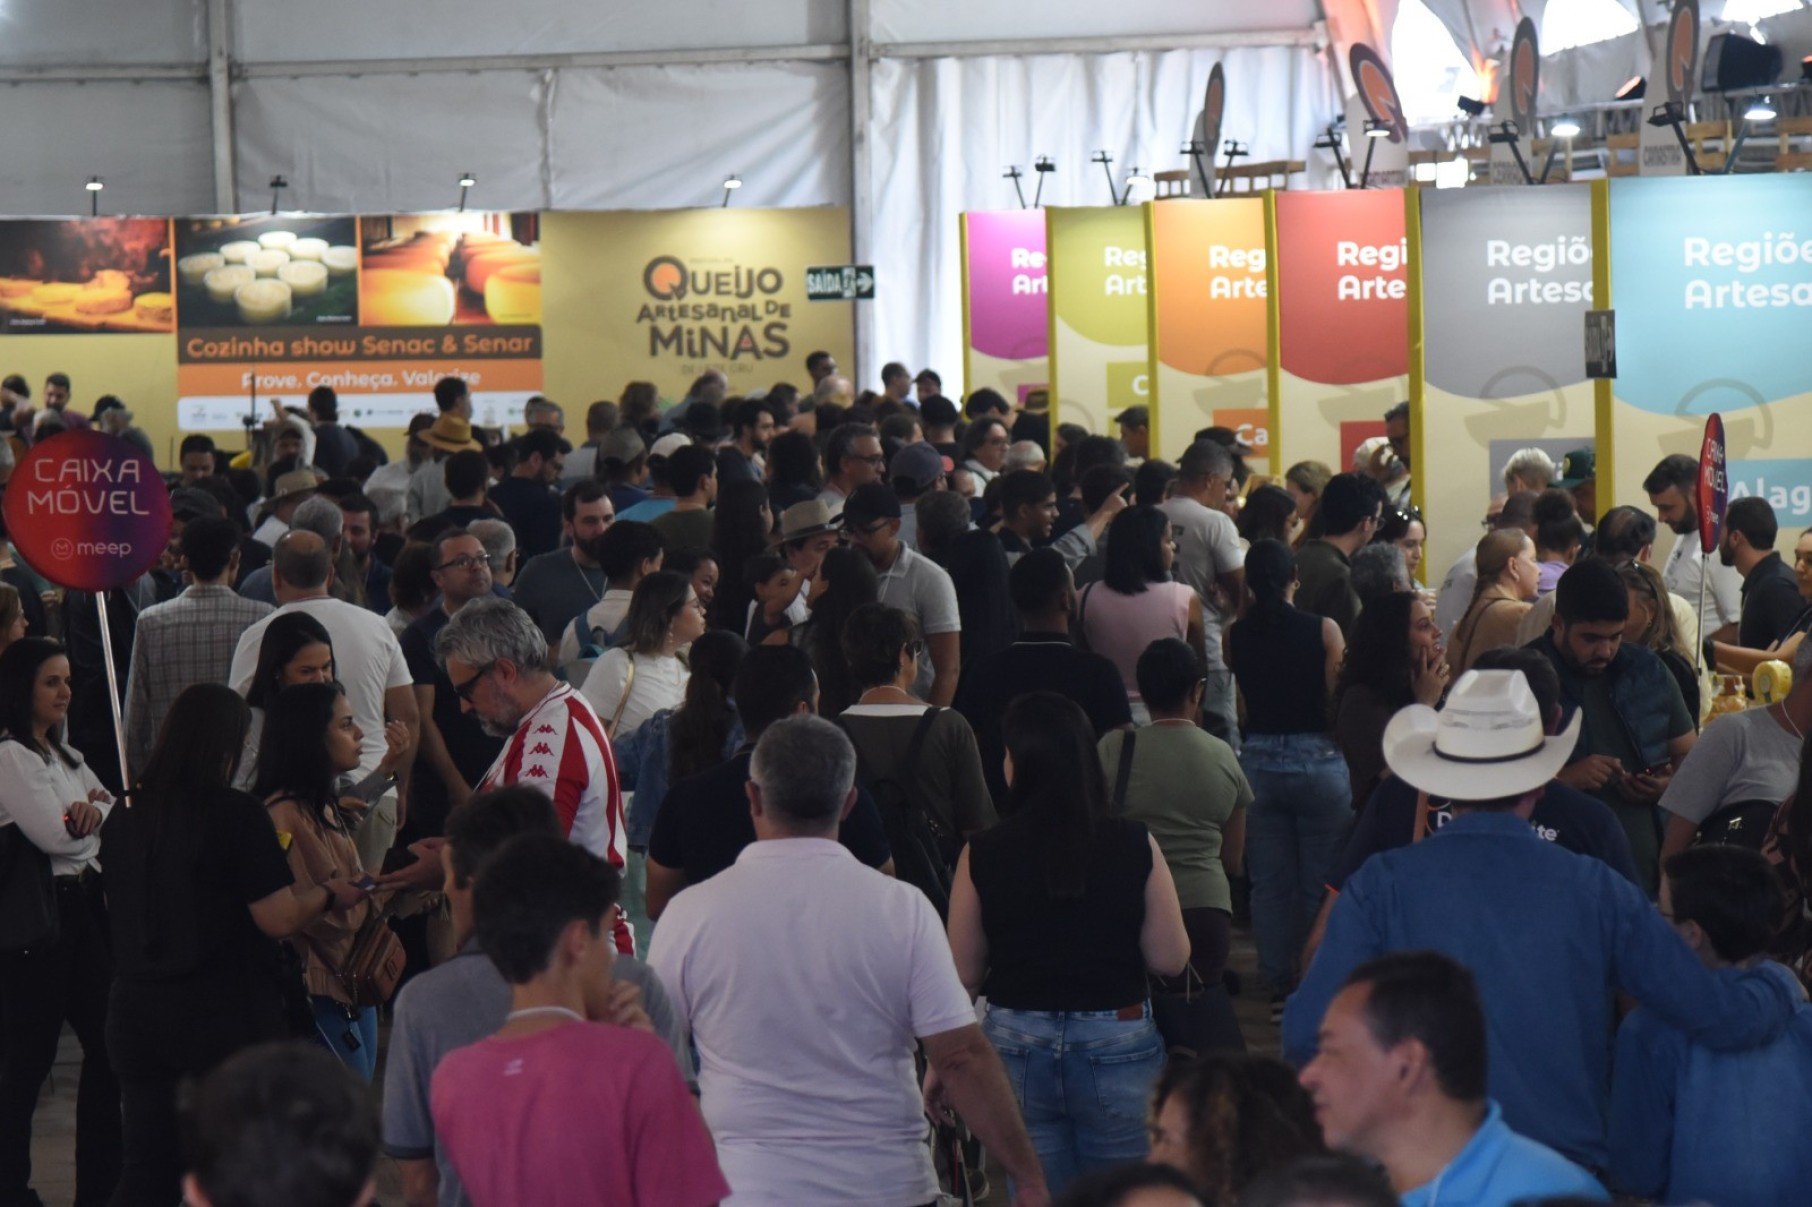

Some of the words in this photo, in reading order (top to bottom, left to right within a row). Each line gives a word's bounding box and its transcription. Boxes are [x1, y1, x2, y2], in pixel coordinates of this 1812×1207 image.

[1011, 247, 1048, 268] Re
[1487, 235, 1593, 272] Regiõ
[807, 268, 841, 294] SAÍDA
[765, 300, 791, 318] DE
[187, 336, 285, 358] Cozinha
[291, 336, 357, 356] show
[362, 335, 435, 355] Senac
[441, 334, 458, 354] &
[464, 334, 533, 354] Senar
[35, 458, 140, 483] CAIXA
[27, 484, 149, 515] MÓVEL
[77, 542, 132, 558] meep
